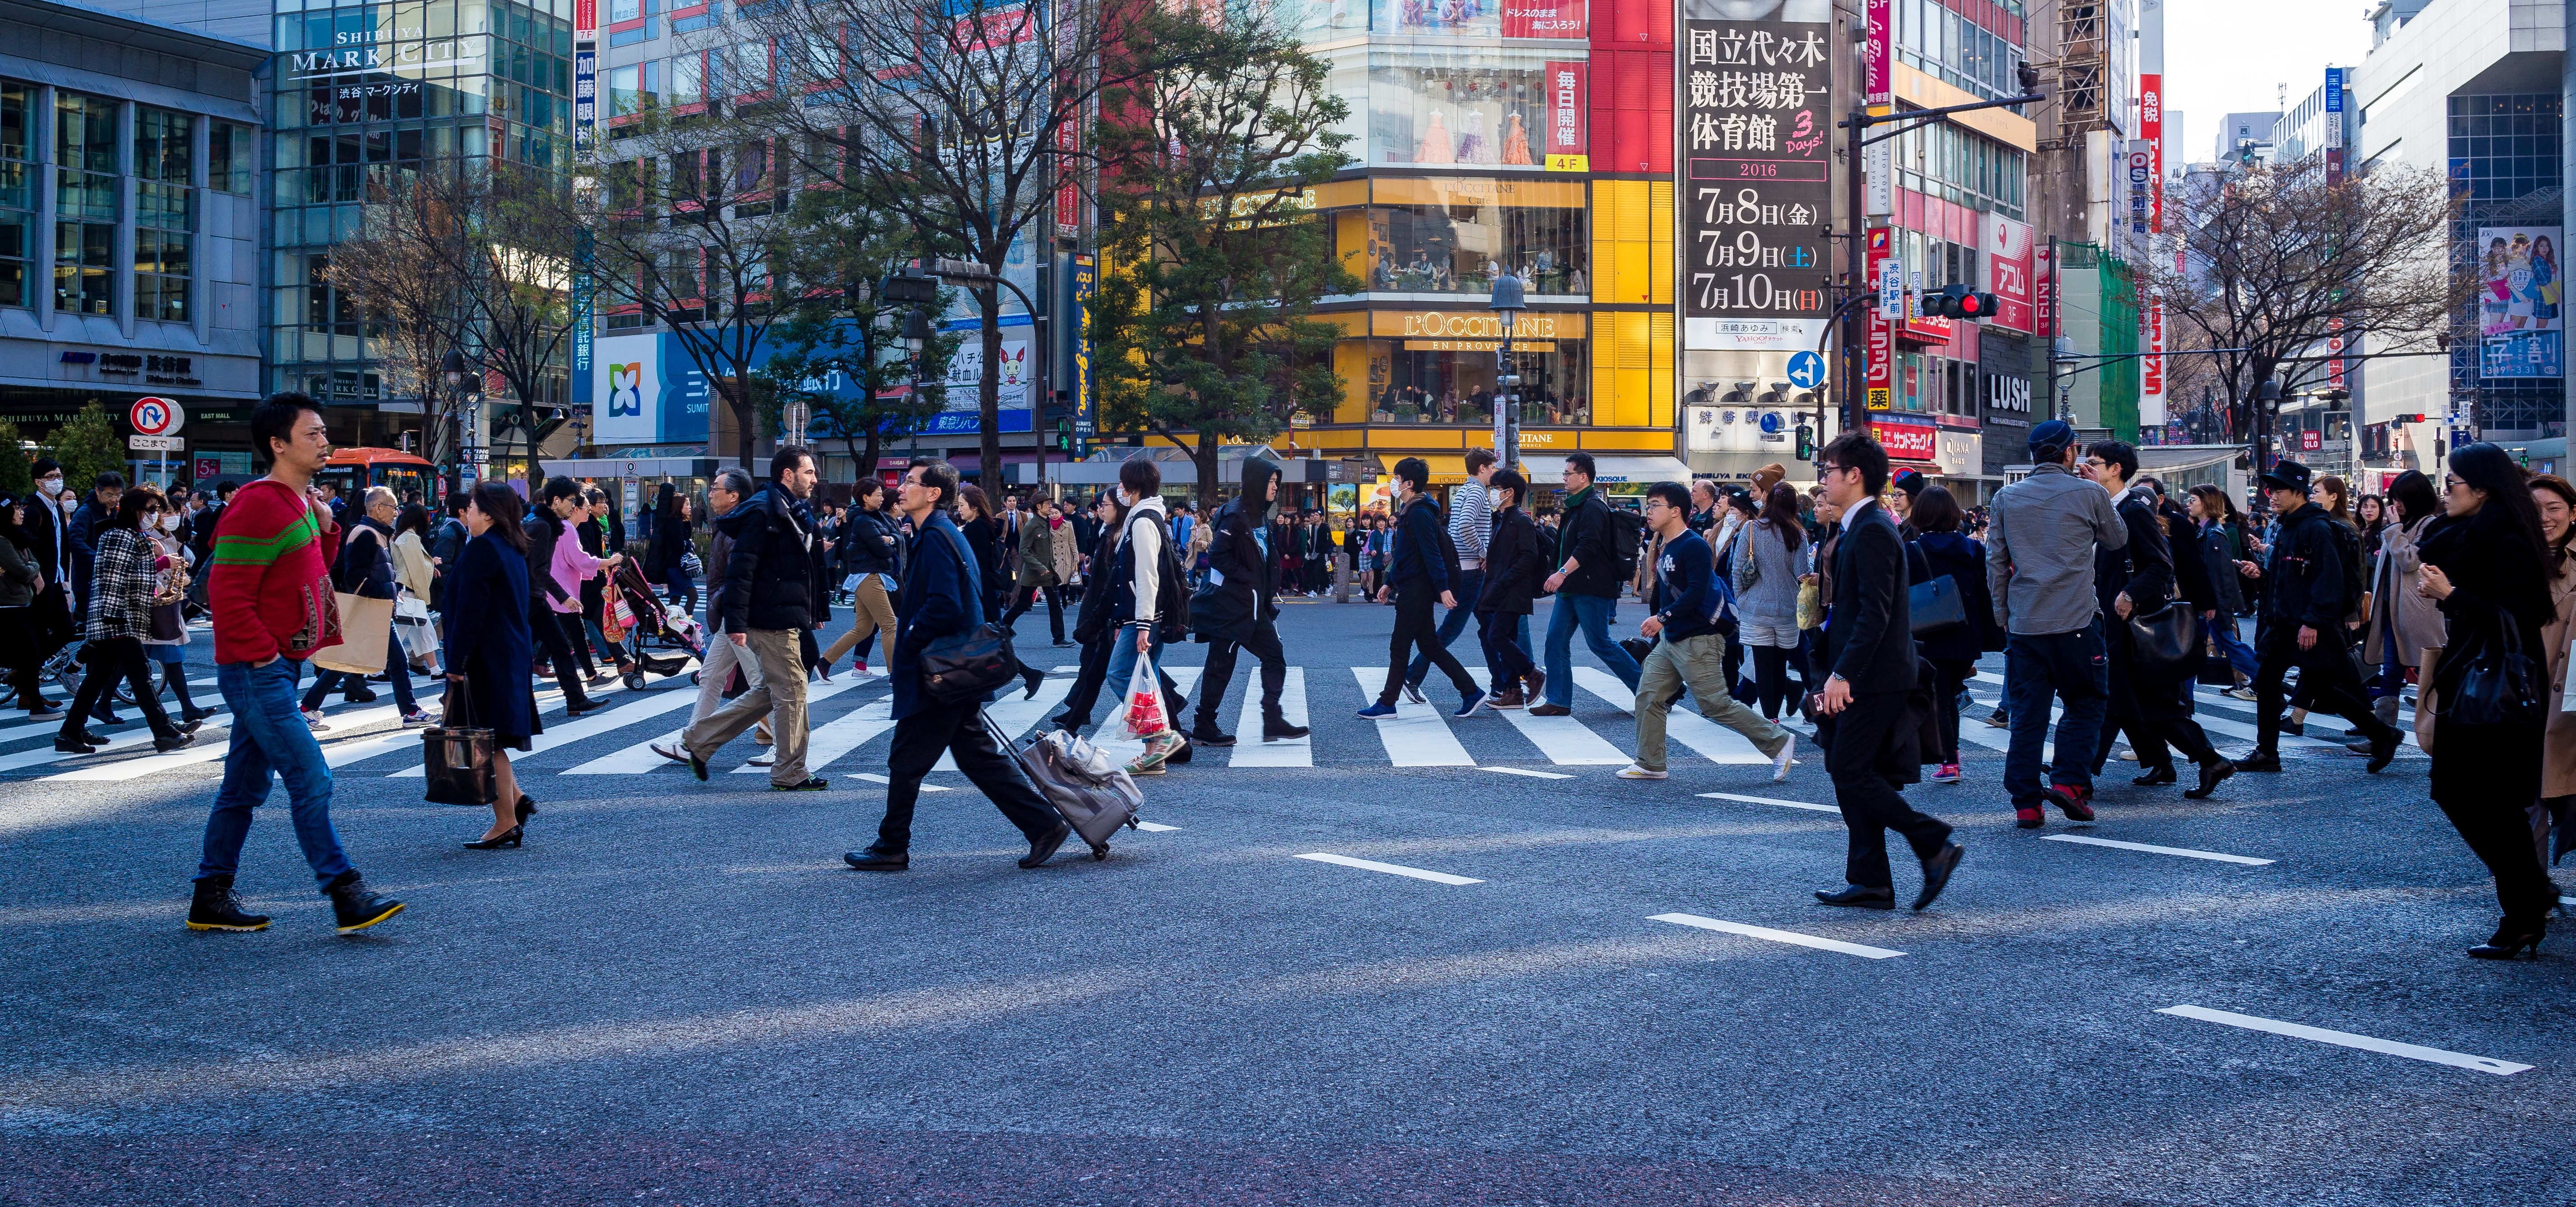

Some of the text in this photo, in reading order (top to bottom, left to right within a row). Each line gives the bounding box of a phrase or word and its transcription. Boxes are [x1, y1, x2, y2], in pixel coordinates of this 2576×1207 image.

[1507, 9, 1557, 18] ドレスのまま
[337, 27, 424, 44] SHIBUYA
[1532, 20, 1580, 30] 海に入ろう!
[292, 41, 476, 72] MARK CITY
[1690, 29, 1826, 68] 国立代々木
[340, 83, 419, 99] 渋谷 マークシティ
[577, 57, 594, 145] 加藤眼科
[1689, 71, 1827, 109] 競技場第一
[1868, 92, 1889, 103] 美容室
[2329, 74, 2339, 109] THE PRIME
[1557, 71, 1576, 146] 毎日開催
[2143, 91, 2158, 122] 免税
[1690, 113, 1777, 151] 体育館
[1792, 109, 1812, 138] 3
[1786, 130, 1823, 156] Days!
[1740, 164, 1777, 176] 2016
[1699, 187, 1817, 225] 7月8日(金)
[1699, 230, 1817, 268] 7月9日(土)
[1076, 272, 1092, 283] パスタ
[1889, 263, 1900, 314] 渋谷駅前
[1999, 262, 2025, 296] アコム
[1693, 273, 1823, 311] 7月10日(日)
[1404, 312, 1555, 338] L'OCCITANE
[2008, 305, 2016, 323] 3F
[1721, 324, 1768, 332] 浜崎あゆみ
[1457, 342, 1528, 351] PROVECE
[2487, 332, 2556, 363] 学割
[952, 368, 982, 382] 献血ル
[319, 383, 350, 392] MRK
[352, 386, 375, 394] CTY
[1871, 390, 1887, 407] 薬
[1991, 374, 2030, 413] LUSH
[687, 403, 709, 413] SUMIT
[132, 439, 167, 448] ここまで
[1490, 434, 1553, 442] LCITANE
[1894, 431, 1926, 450] サンドラッグ
[1946, 438, 1969, 455] DIANA
